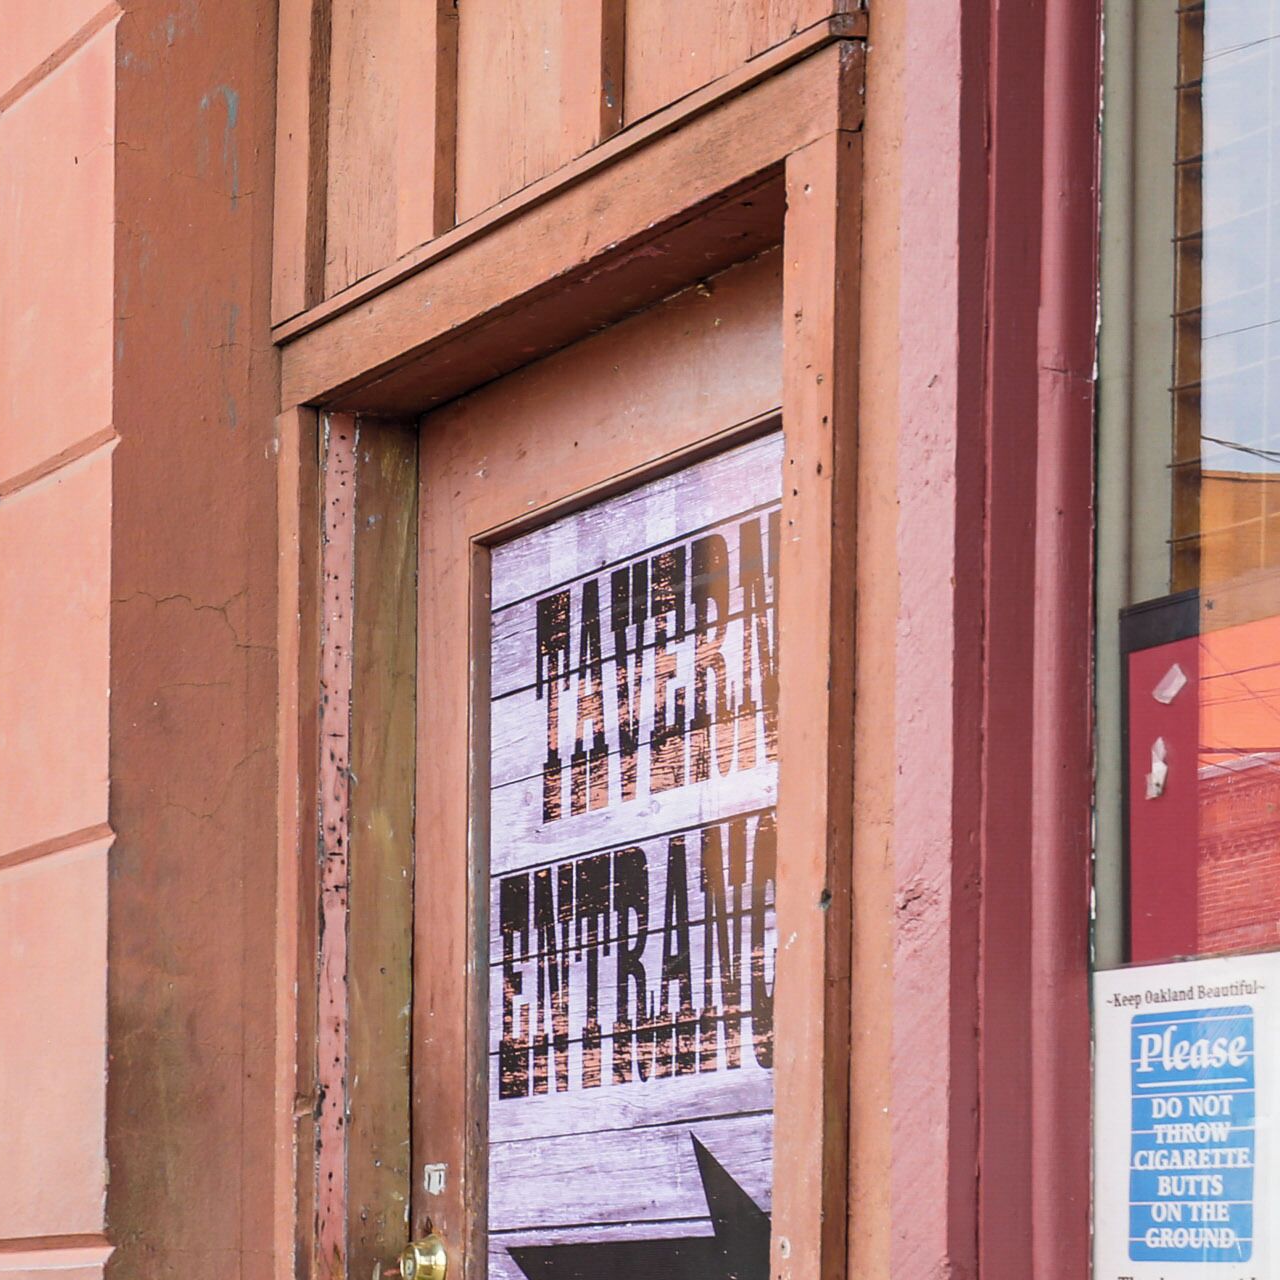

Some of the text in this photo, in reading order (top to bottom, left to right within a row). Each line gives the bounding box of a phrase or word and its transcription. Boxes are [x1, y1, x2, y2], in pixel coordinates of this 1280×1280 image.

[536, 511, 780, 824] TAVERN
[1145, 985, 1194, 1005] Oakland
[1135, 1025, 1249, 1073] Please
[1151, 1095, 1234, 1119] DO NOT
[1153, 1121, 1231, 1144] THROW
[1133, 1147, 1251, 1170] CIGARETTE
[1157, 1174, 1224, 1197] BUTTS
[1151, 1202, 1230, 1223] ON THE
[1145, 1227, 1236, 1249] GROUND
